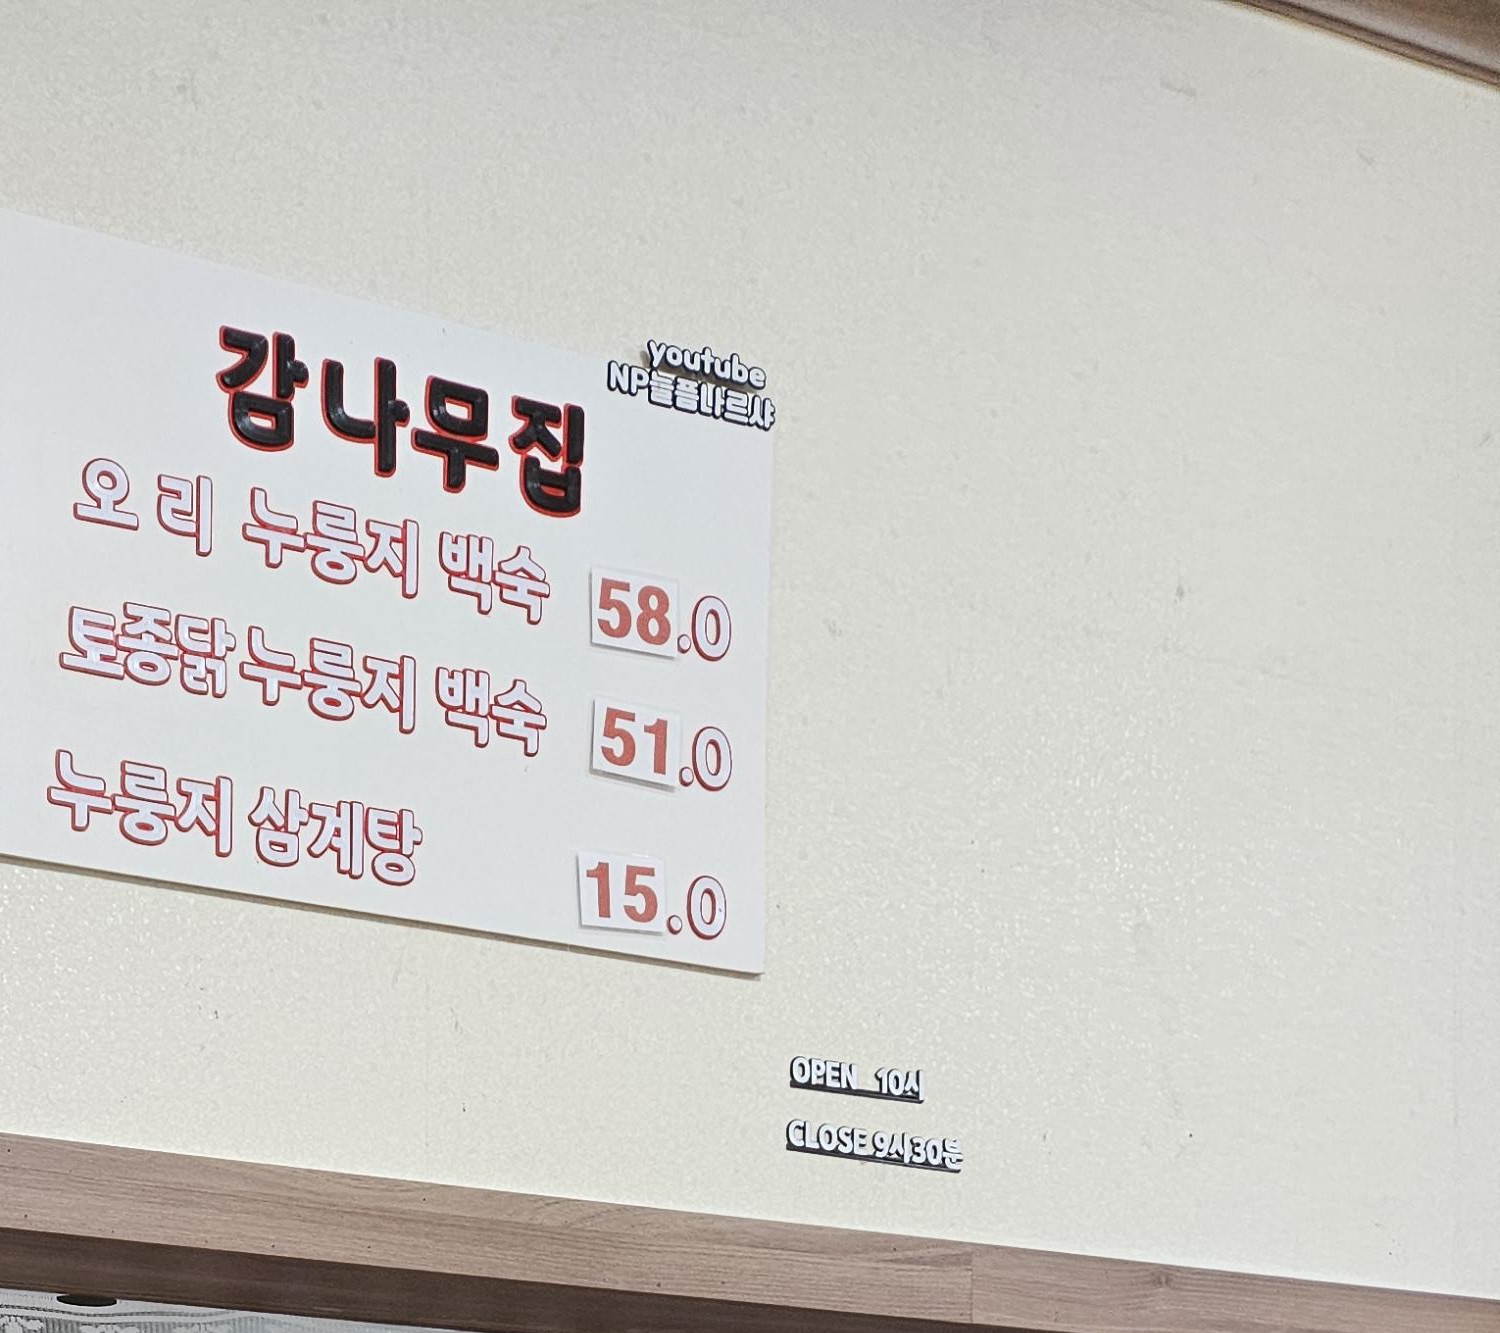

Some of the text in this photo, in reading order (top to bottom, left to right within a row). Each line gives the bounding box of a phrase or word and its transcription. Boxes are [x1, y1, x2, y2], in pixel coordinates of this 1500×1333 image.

[217, 324, 586, 518] 감나무집
[647, 339, 767, 391] youtube
[242, 487, 419, 599] 누룽지
[439, 531, 550, 625] 백숙
[597, 577, 732, 662] 58.0
[59, 601, 733, 792] 토종닭 누룽지 백숙 51.0
[47, 749, 727, 940] 누룽지 삼계탕 15.0
[786, 1119, 869, 1156] CLOSE
[789, 1056, 924, 1101] OPEN 10시
